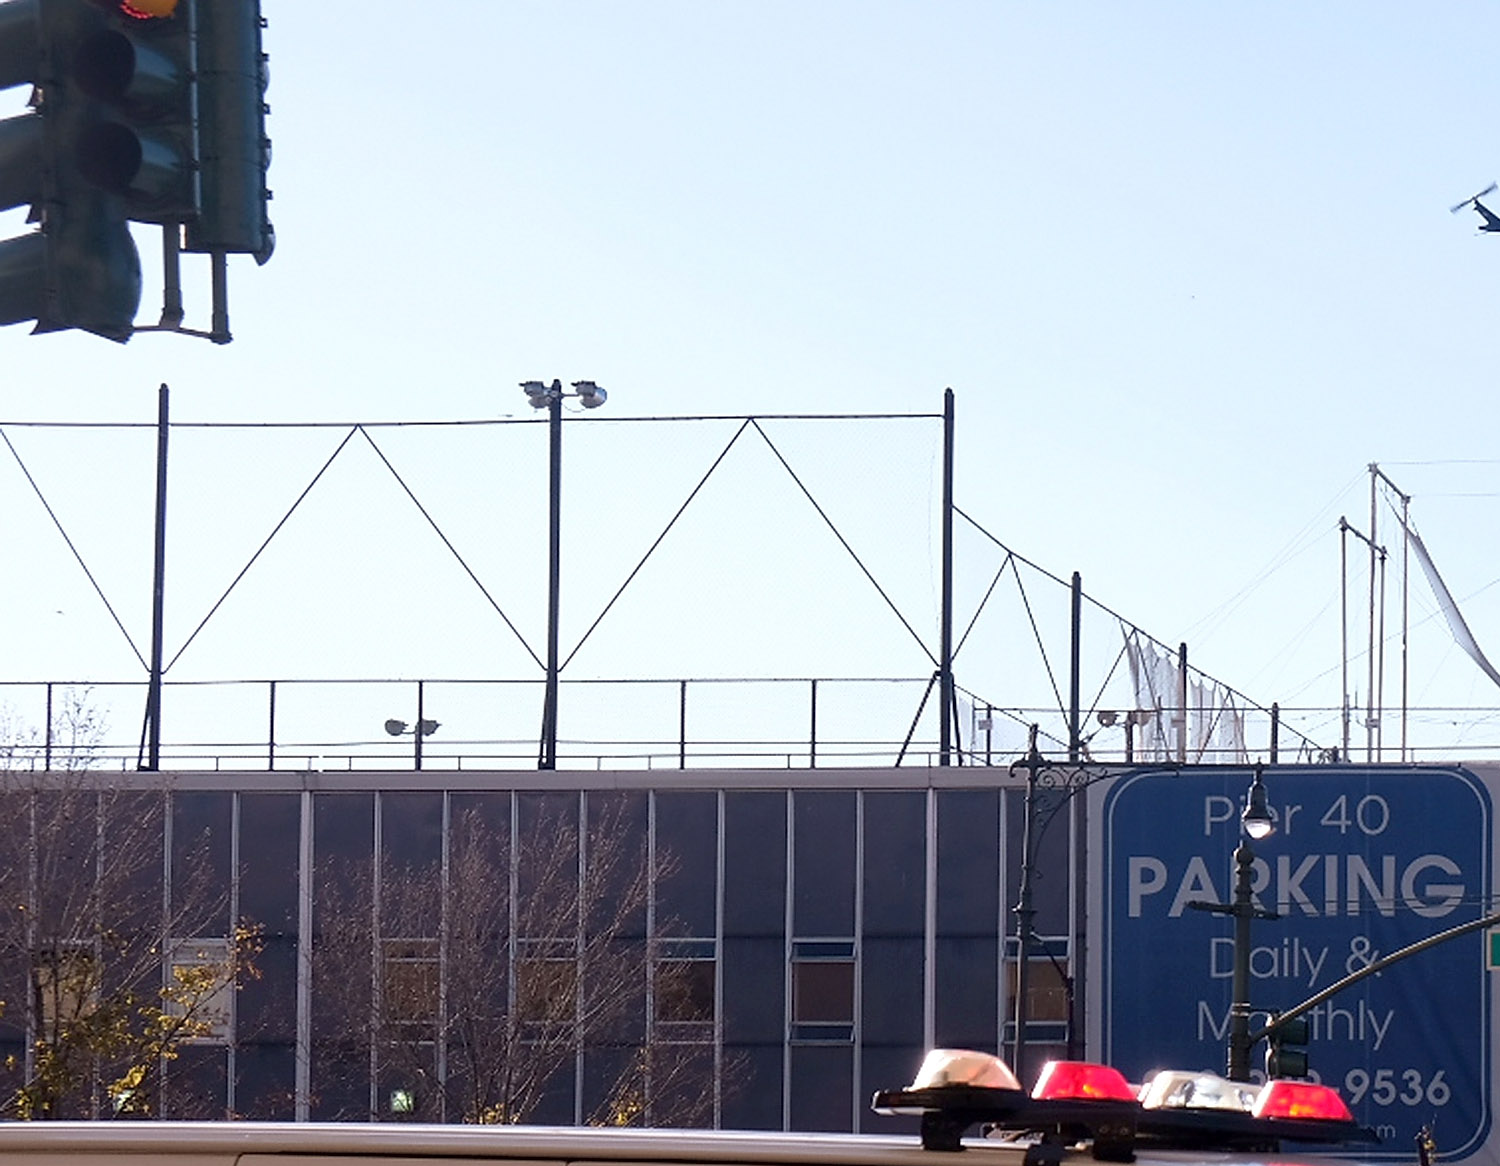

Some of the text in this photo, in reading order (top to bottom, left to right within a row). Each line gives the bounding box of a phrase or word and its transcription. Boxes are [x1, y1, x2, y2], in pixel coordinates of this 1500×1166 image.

[1320, 794, 1390, 836] 40
[1128, 854, 1466, 918] PARKING
[1211, 936, 1382, 988] Daily &
[1197, 1000, 1394, 1051] Mothly
